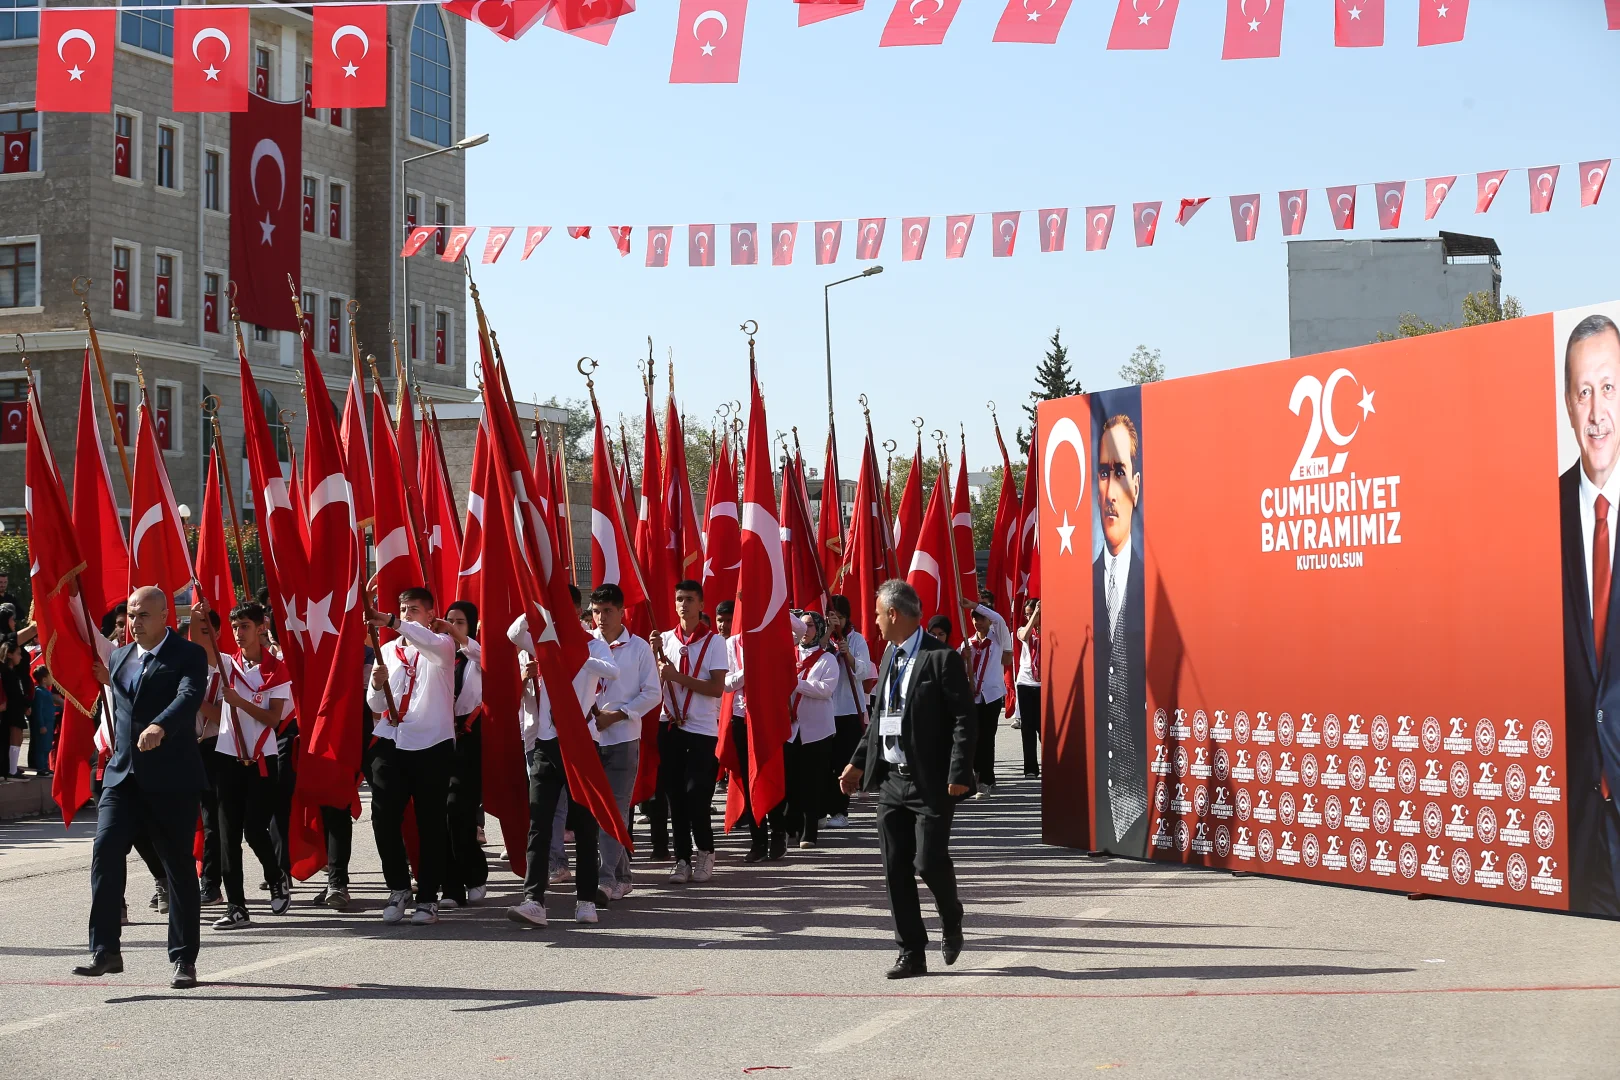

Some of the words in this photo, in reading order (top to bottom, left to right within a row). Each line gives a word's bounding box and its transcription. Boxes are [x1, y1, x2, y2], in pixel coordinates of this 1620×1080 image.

[1299, 462, 1325, 478] EKİM
[1260, 472, 1400, 518] CUMHURİYET
[1261, 512, 1402, 552] BAYRAMIMIZ
[1296, 554, 1328, 570] KUTLU
[1330, 552, 1363, 569] OLSUN
